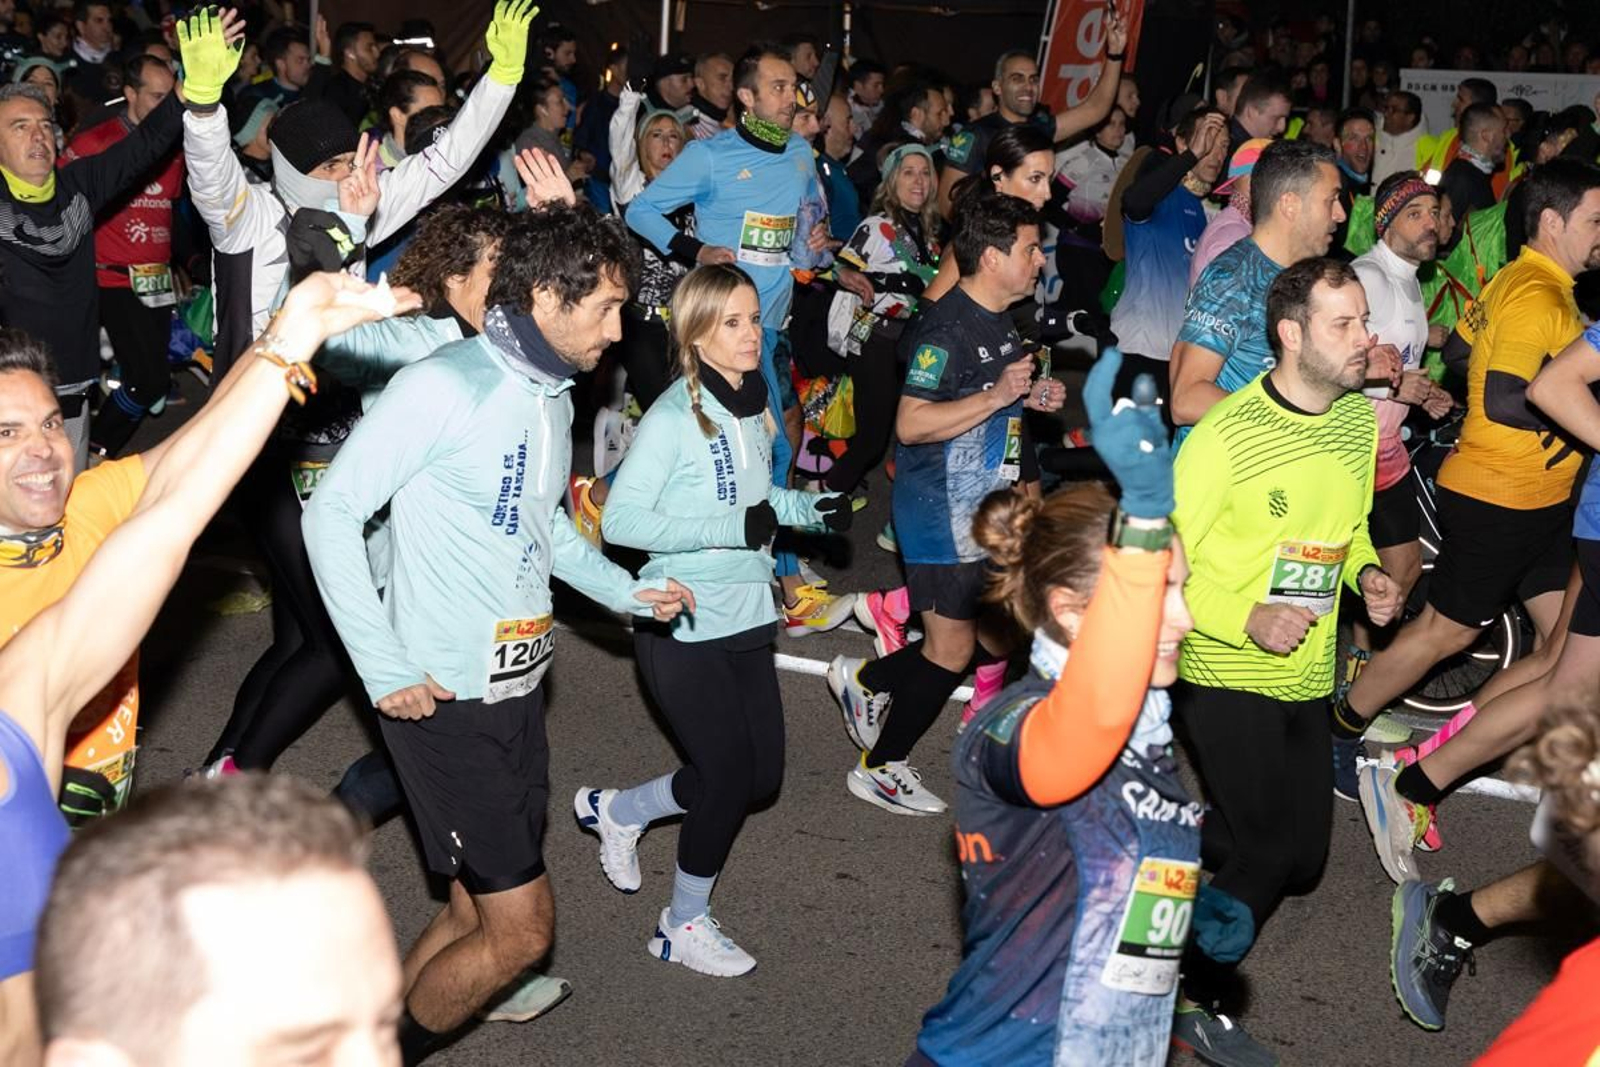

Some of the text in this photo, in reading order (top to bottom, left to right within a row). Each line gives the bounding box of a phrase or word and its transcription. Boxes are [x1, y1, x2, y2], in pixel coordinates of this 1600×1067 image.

[1058, 0, 1106, 107] de
[713, 459, 728, 501] CONTIGO
[728, 480, 737, 506] CADA
[491, 476, 513, 527] CONTIGO
[505, 505, 519, 536] CADA
[1302, 545, 1322, 560] 42
[1278, 562, 1341, 591] 281
[516, 621, 535, 636] 42
[1163, 867, 1187, 891] 42
[1147, 898, 1193, 945] 90
